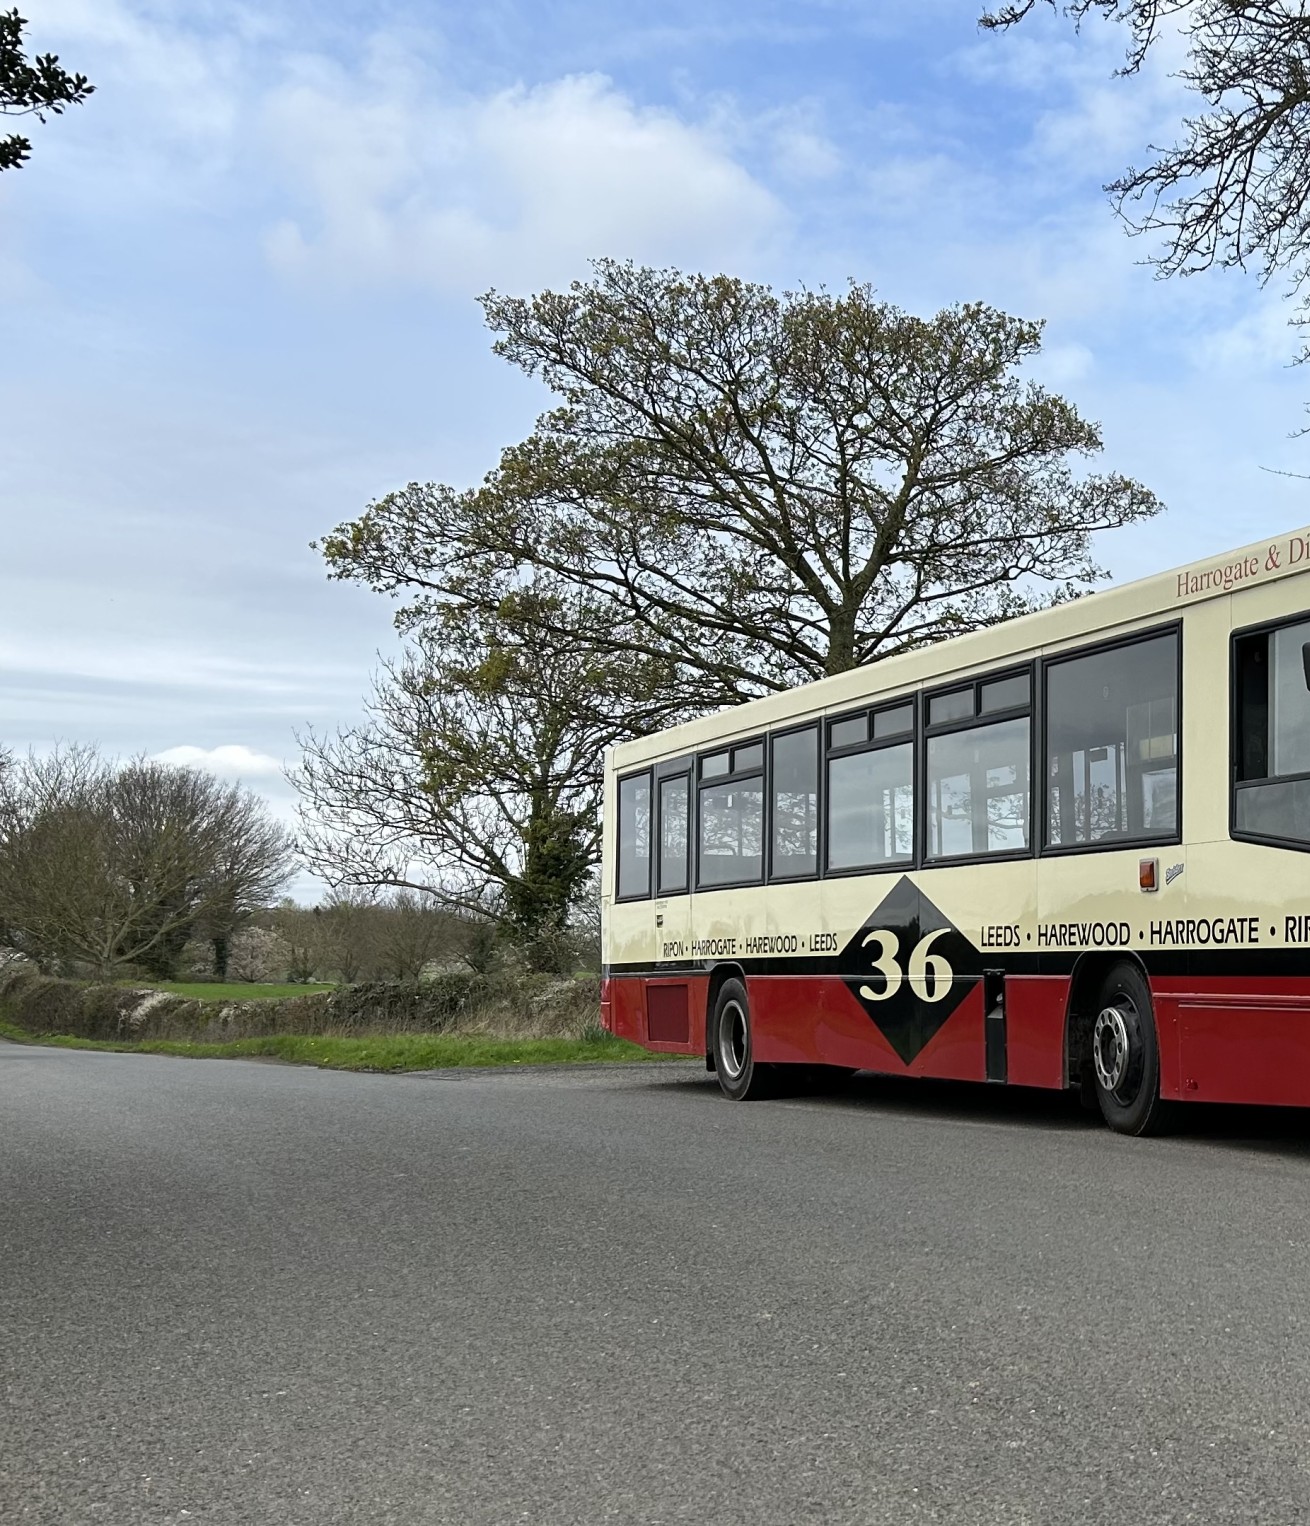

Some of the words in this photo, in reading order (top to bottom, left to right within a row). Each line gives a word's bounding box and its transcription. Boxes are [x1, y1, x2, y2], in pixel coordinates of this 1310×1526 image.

[1177, 557, 1259, 597] Harrogate
[1265, 544, 1281, 571] &
[663, 941, 684, 958] RIPON
[691, 938, 737, 956] HARROGATE
[745, 935, 798, 954] HAREWOOD
[809, 933, 838, 952] LEEDS
[981, 924, 1021, 948] LEEDS
[1037, 921, 1131, 946] HAREWOOD
[1150, 917, 1260, 945] HARROGATE
[859, 928, 954, 1003] 36
